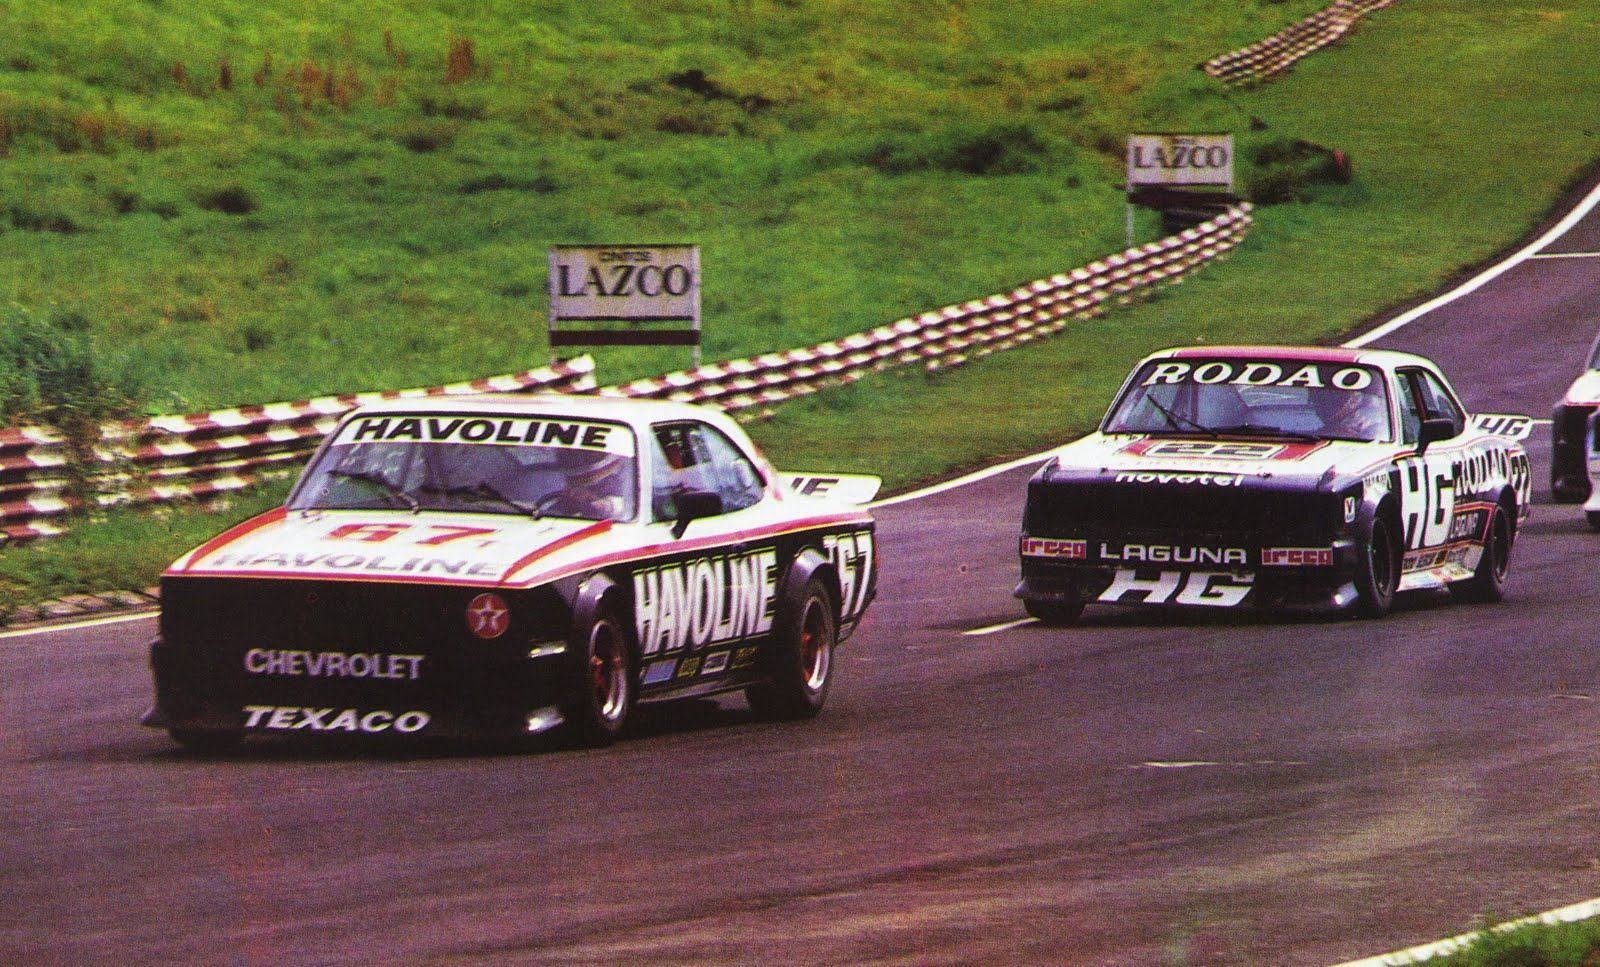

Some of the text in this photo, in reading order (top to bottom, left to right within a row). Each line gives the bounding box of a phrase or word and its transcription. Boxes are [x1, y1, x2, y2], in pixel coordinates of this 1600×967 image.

[1133, 145, 1229, 168] LAZCO
[557, 264, 691, 297] LAZCO
[1141, 361, 1372, 390] RODAO
[354, 418, 612, 448] HAVOLINE
[1115, 472, 1245, 487] novotel
[1397, 453, 1454, 549] HG
[323, 522, 500, 546] 67
[212, 552, 500, 577] HAVOLINE
[1100, 542, 1247, 564] LAGUNA
[633, 547, 777, 655] HAVOLINE
[1098, 569, 1255, 606] HG
[244, 648, 428, 680] CHEVROLET
[242, 705, 432, 732] TEXACO
